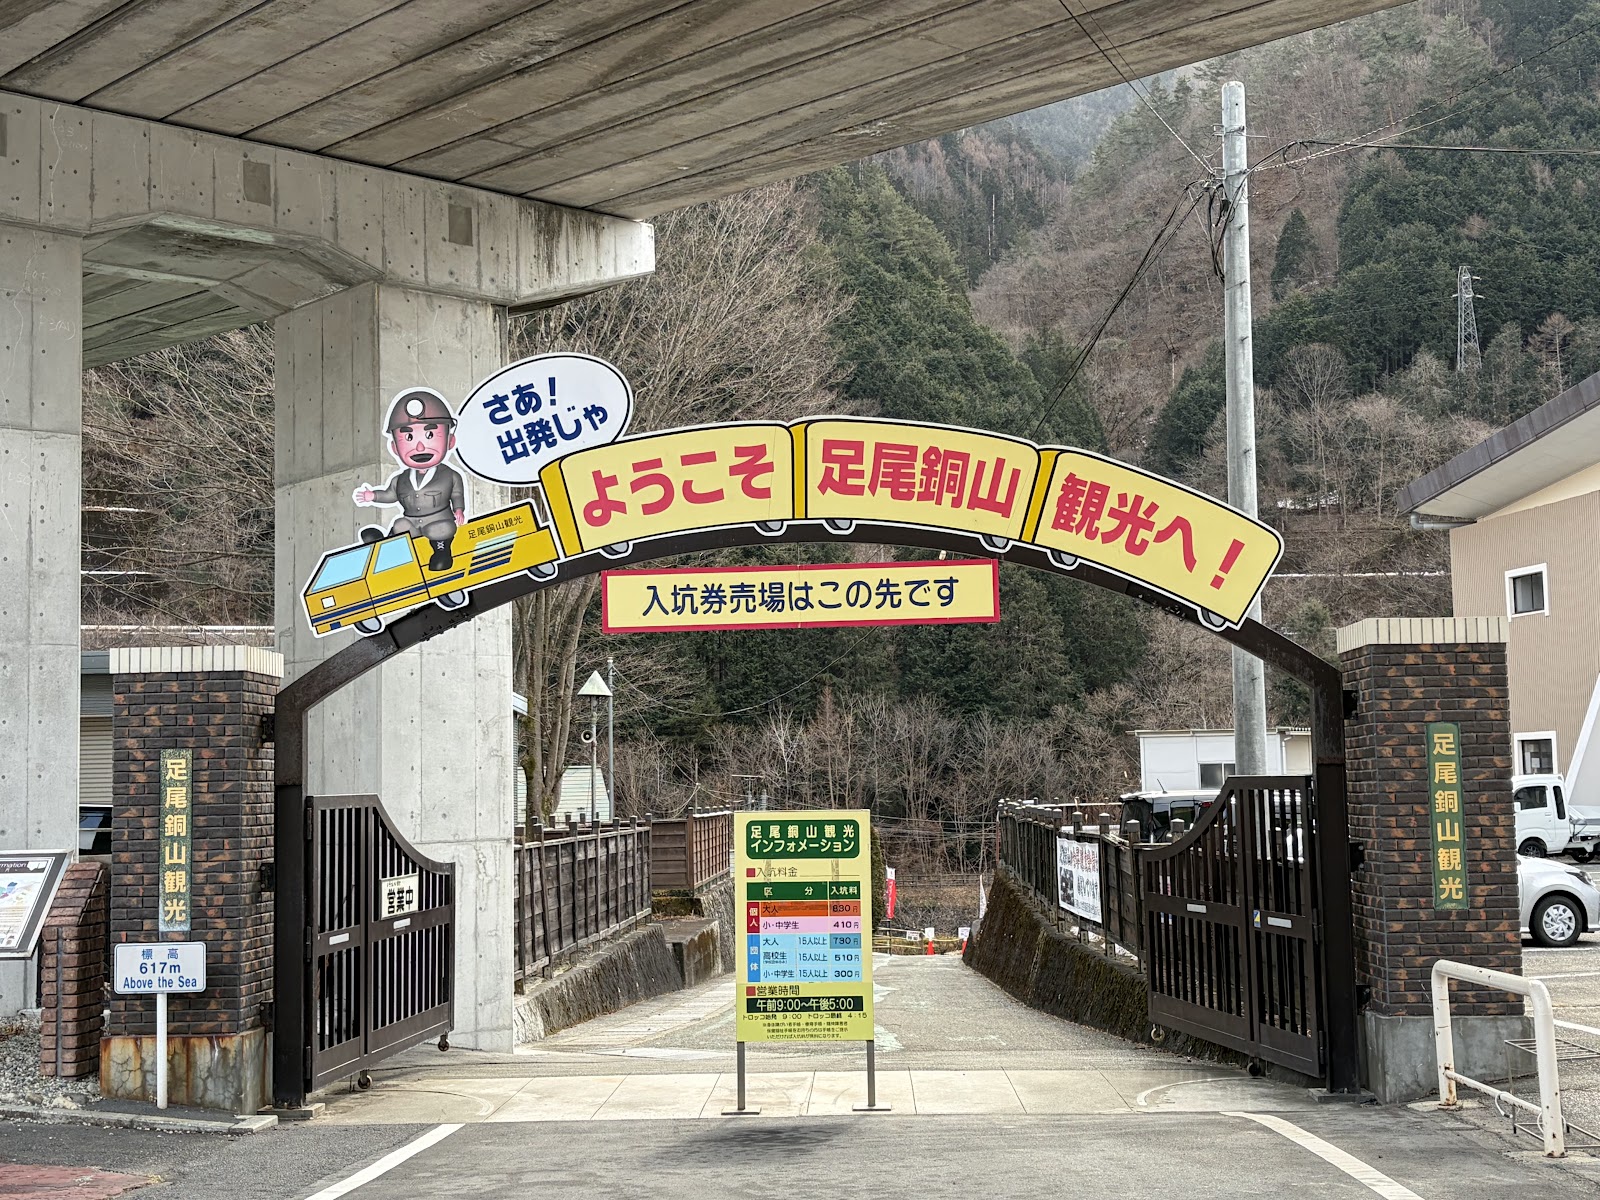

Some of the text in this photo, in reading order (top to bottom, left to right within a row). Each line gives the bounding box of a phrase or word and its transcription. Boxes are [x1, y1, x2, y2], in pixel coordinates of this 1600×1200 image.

[497, 404, 609, 465] 出発じゃ
[583, 439, 1246, 590] ようこそ 足尾銅山 観光へ！
[467, 515, 524, 540] 足尾銅山観光
[642, 576, 959, 616] 入坑券売場はこの先です
[1433, 733, 1463, 900] 足尾銅山観光
[750, 824, 855, 839] 足尾銅山観光
[164, 759, 187, 921] 足尾銅山観光
[750, 838, 855, 853] インフォメーション
[830, 886, 858, 895] 入坑料
[386, 884, 414, 915] 営業中
[762, 905, 779, 914] 大人
[749, 907, 758, 927] 個人
[762, 921, 859, 930] 小・中学生 410円
[762, 937, 779, 946] 大人
[798, 937, 828, 946] 15人以上
[141, 948, 179, 960] 標高
[762, 951, 860, 962] 高校生 15人以上 510円
[139, 962, 181, 975] 617m
[763, 969, 860, 979] 小・中学生 15人以上 300円
[123, 975, 197, 989] Above the Sea
[756, 985, 800, 997] 営業時間
